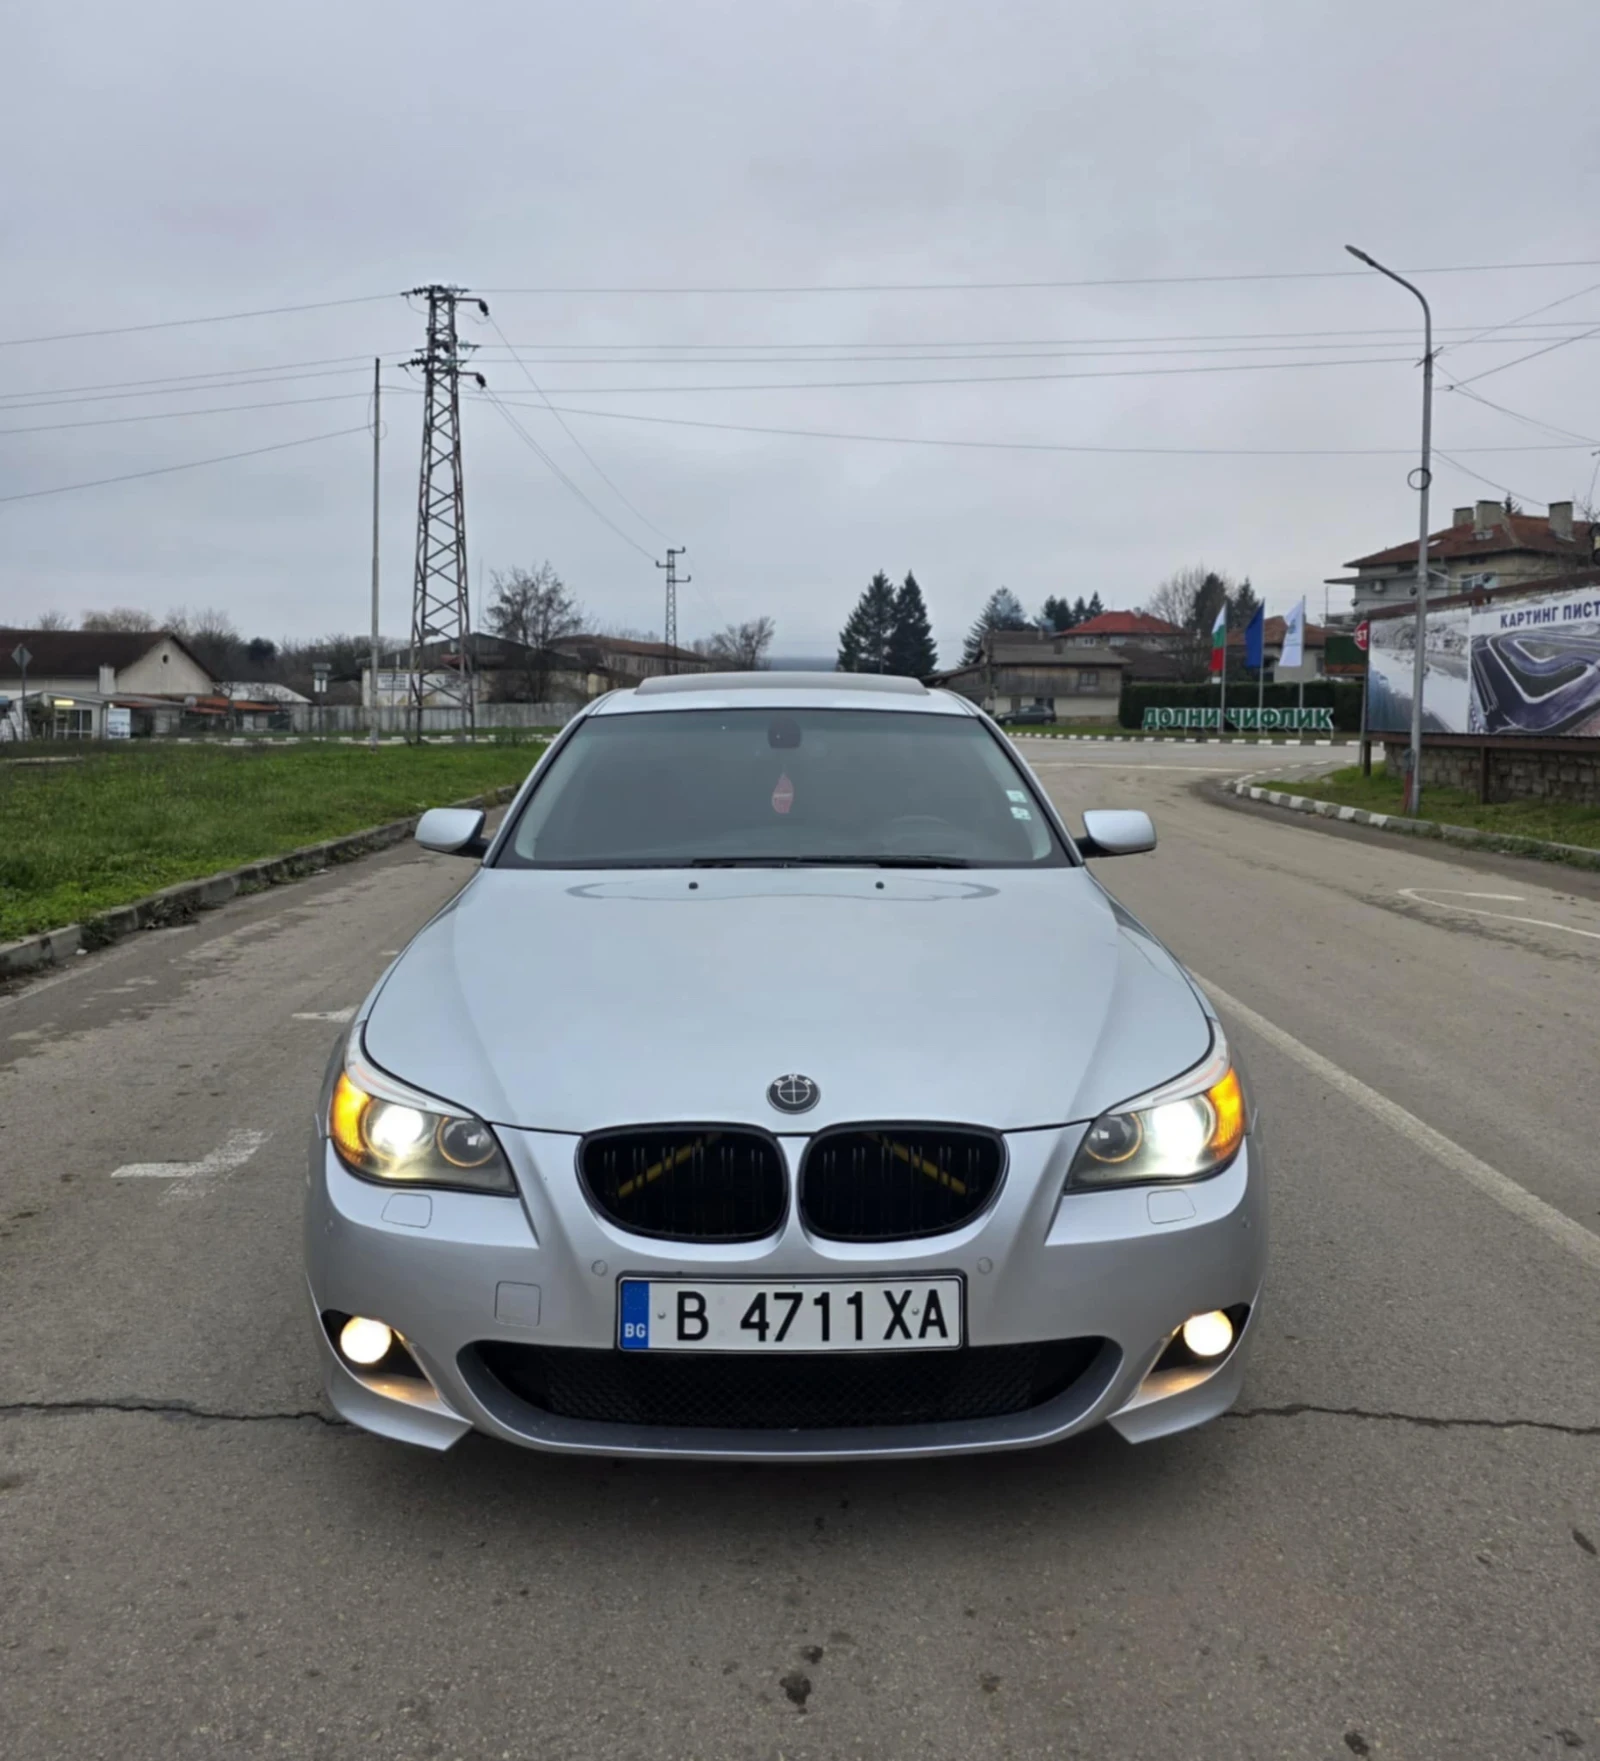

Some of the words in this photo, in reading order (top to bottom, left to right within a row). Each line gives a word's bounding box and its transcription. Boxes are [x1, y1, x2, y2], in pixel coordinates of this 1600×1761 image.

[1500, 606, 1559, 629] КАРТИНГ
[1356, 629, 1368, 641] ST
[1142, 707, 1222, 730] ДОЛНИ
[1224, 707, 1334, 730] ЧИФЛИК
[676, 1290, 709, 1342] B
[740, 1290, 864, 1342] 4711
[883, 1288, 949, 1340] XA
[624, 1322, 646, 1338] BG
